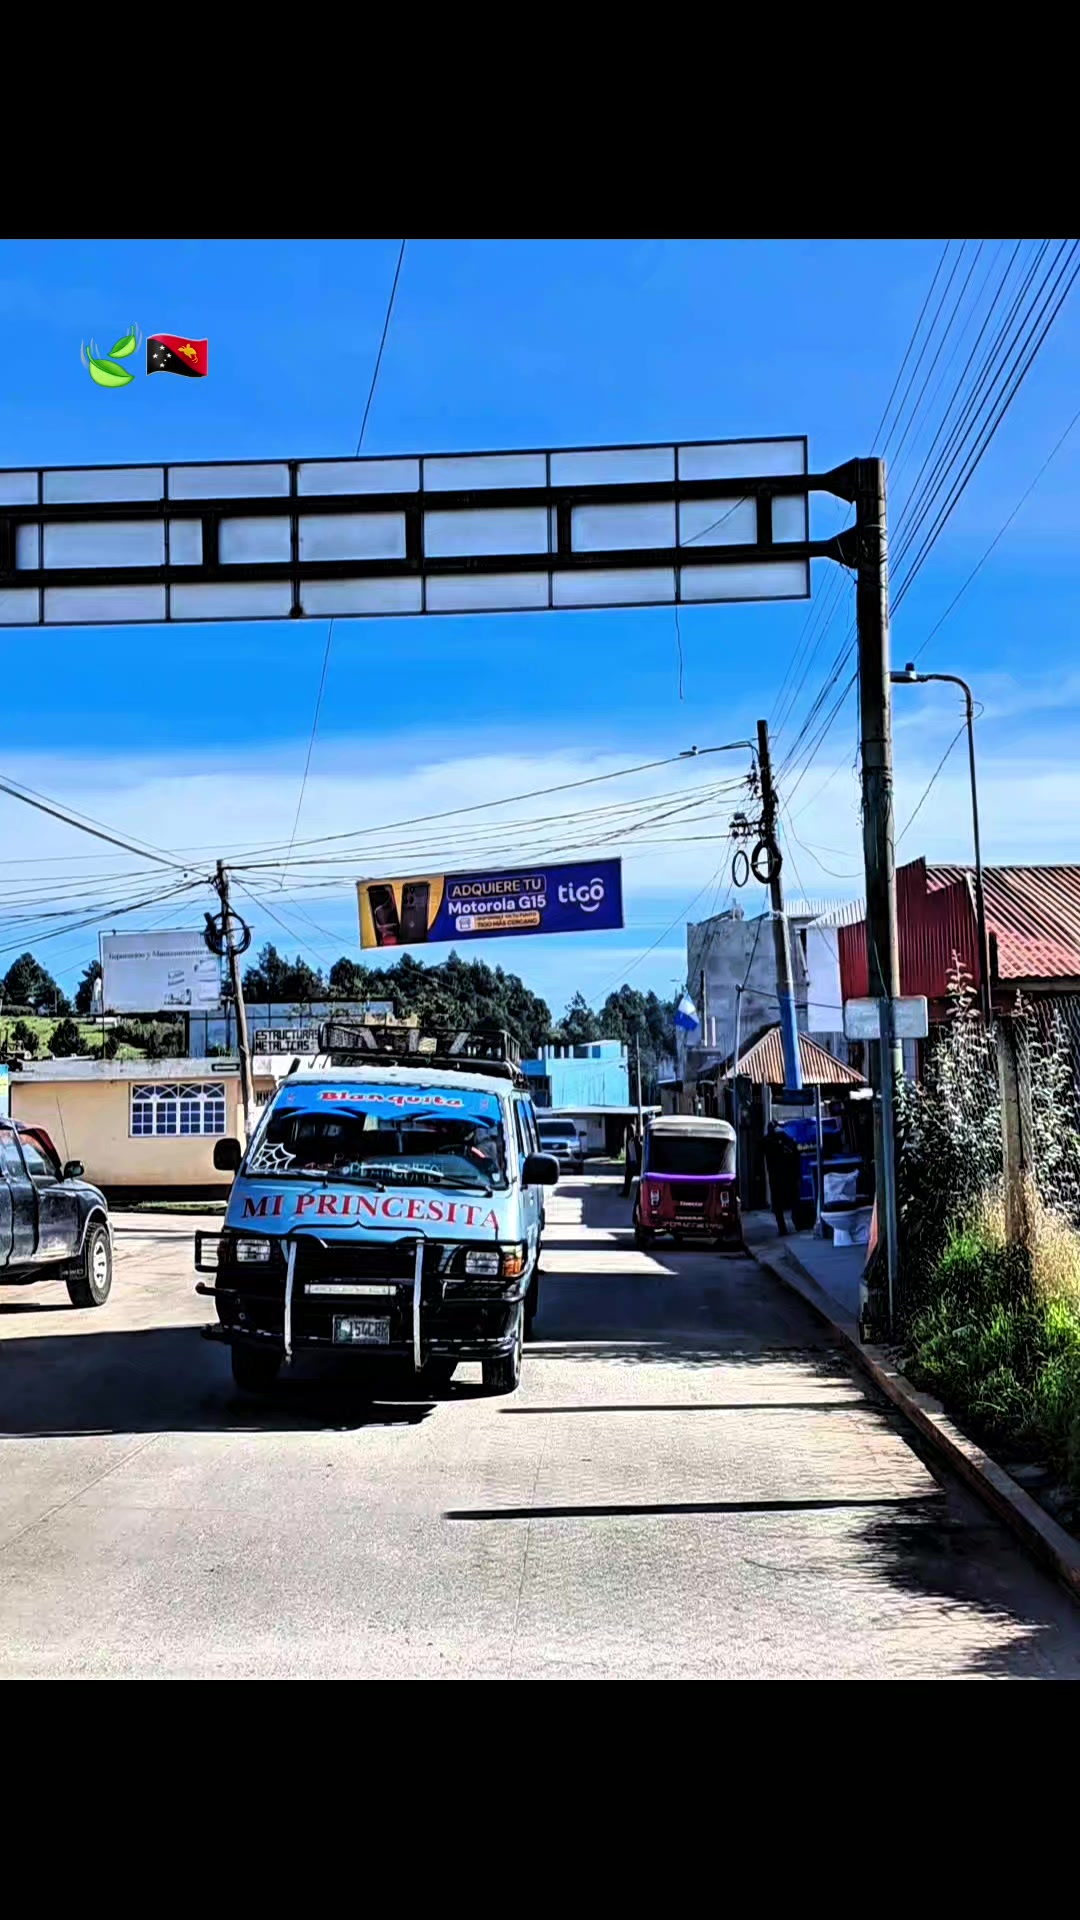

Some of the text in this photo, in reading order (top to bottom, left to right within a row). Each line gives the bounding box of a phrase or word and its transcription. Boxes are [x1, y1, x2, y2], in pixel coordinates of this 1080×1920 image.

[452, 878, 542, 897] ADQUIERE TU
[448, 894, 547, 916] Motorola G15
[255, 1029, 319, 1041] ESTRUCTURAS
[255, 1040, 310, 1052] METALICAS
[320, 1091, 464, 1108] Blanquita
[242, 1194, 499, 1230] MI PRINCESITA
